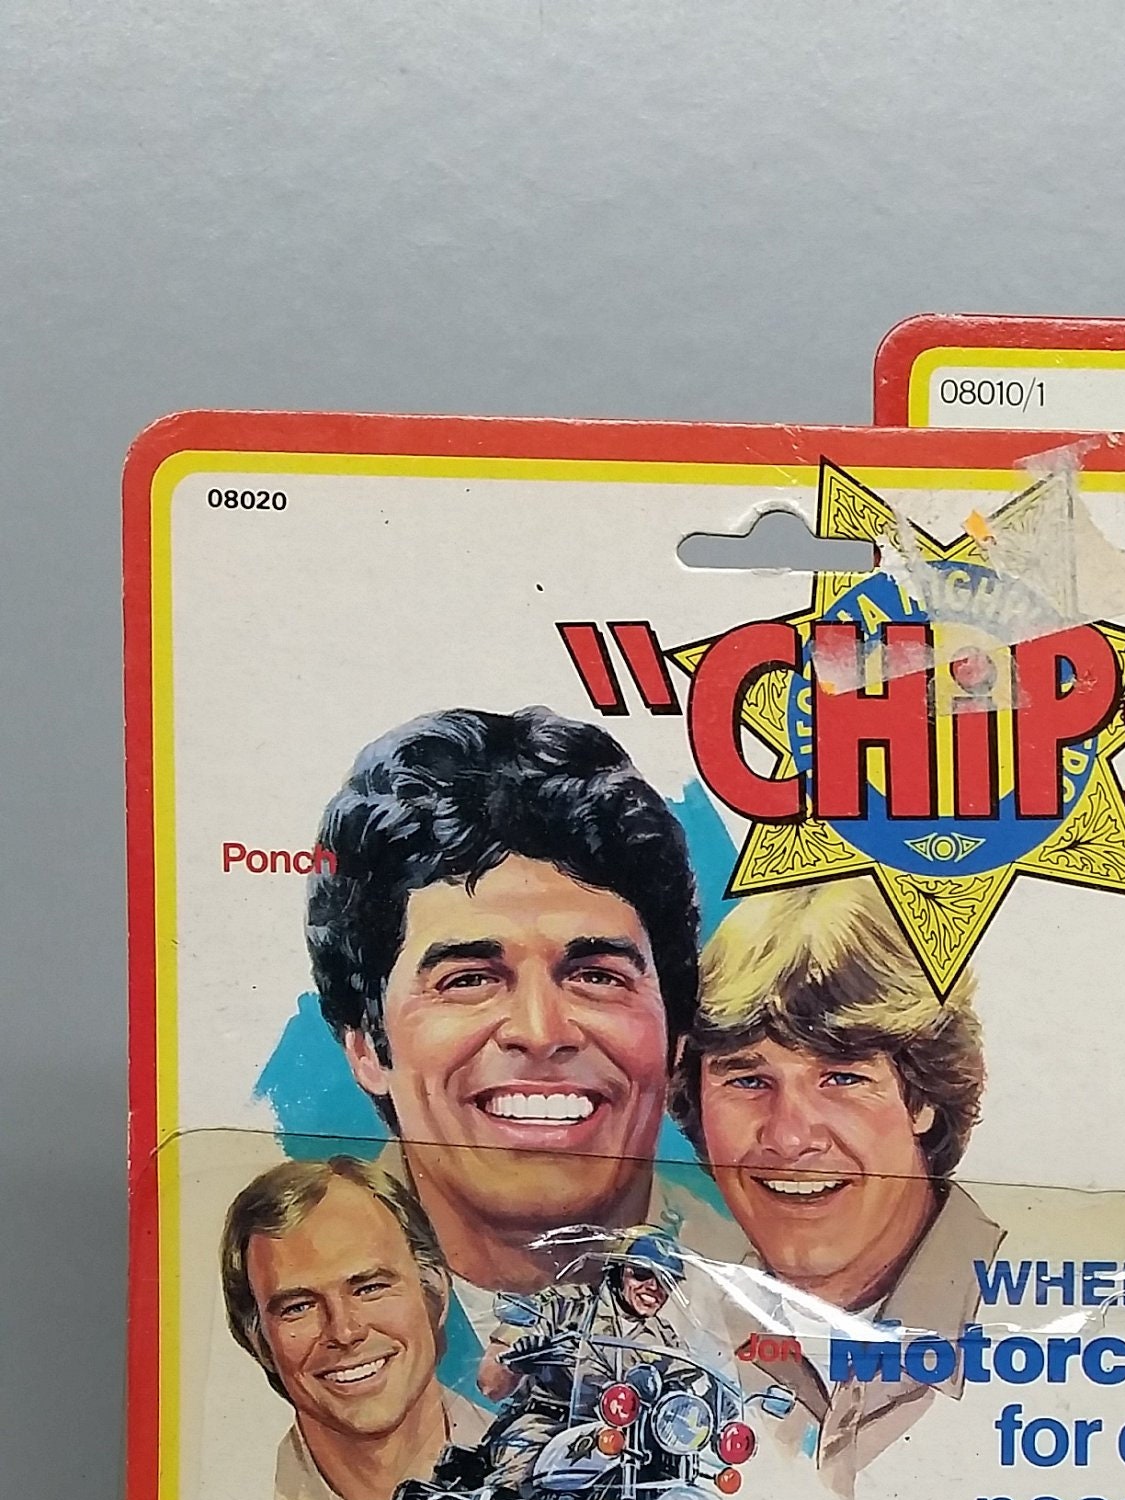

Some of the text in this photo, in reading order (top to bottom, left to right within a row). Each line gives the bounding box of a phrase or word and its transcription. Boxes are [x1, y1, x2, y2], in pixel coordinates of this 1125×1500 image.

[940, 377, 1045, 413] 08010/1
[207, 488, 288, 511] 08020
[222, 842, 337, 875] Ponch
[737, 1332, 802, 1363] Jon
[996, 1404, 1102, 1466] for
